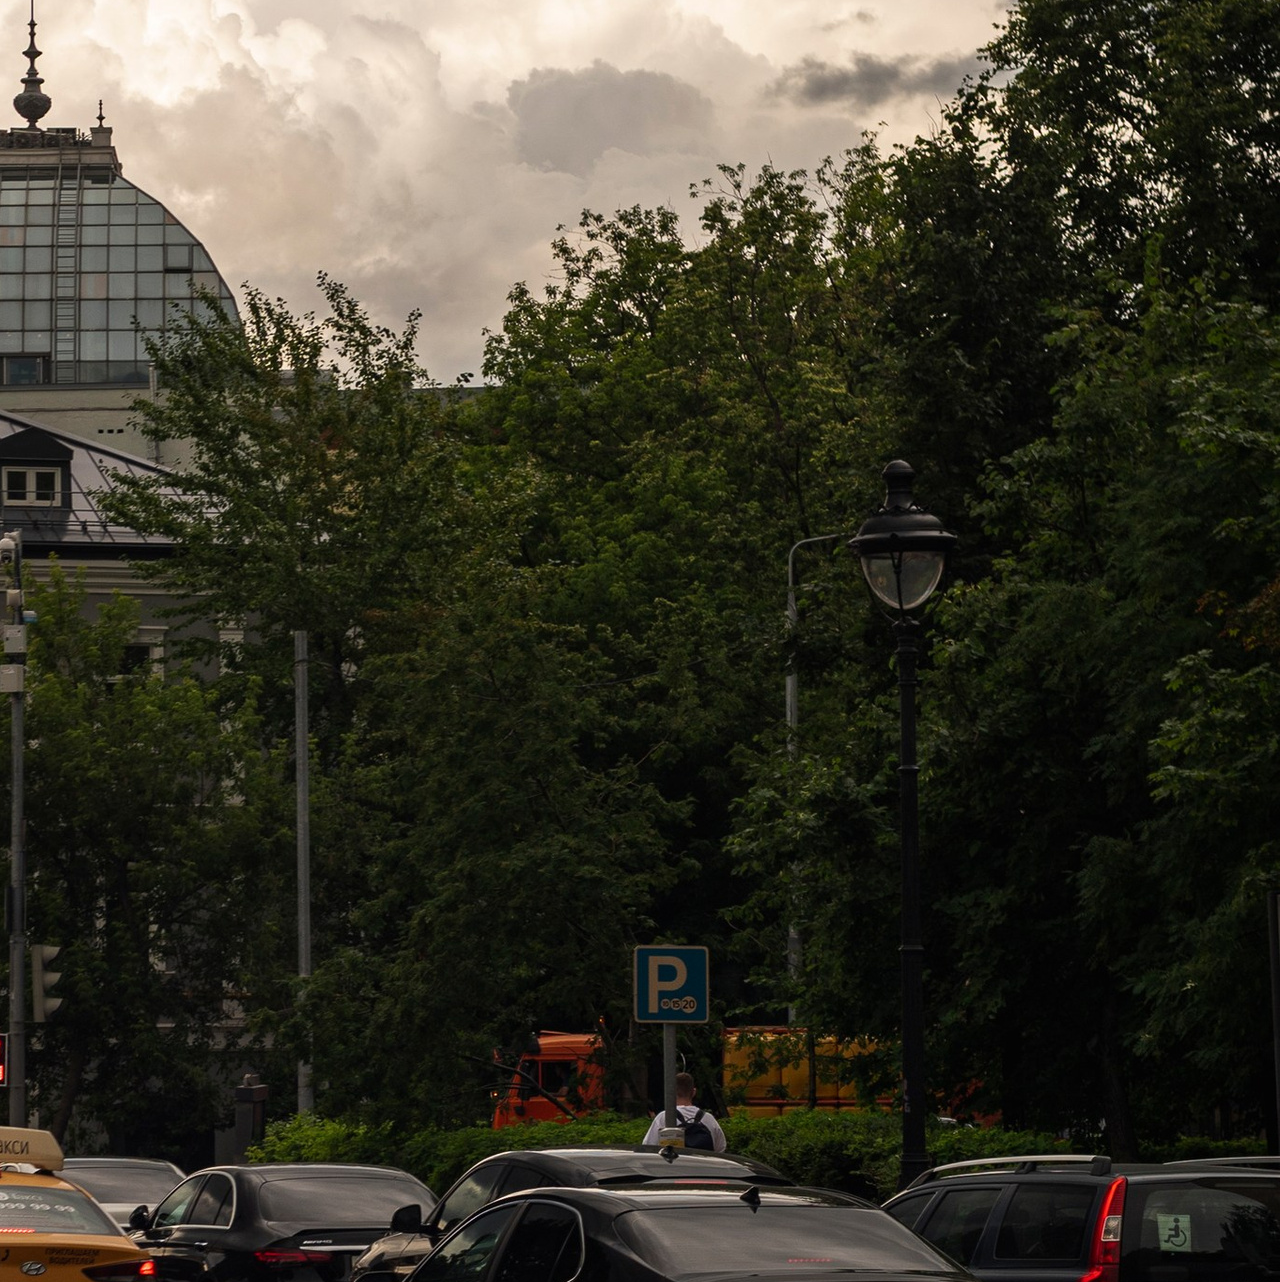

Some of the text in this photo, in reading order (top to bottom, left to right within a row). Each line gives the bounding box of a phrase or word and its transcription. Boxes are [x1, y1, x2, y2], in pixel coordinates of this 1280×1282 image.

[648, 955, 688, 1014] P
[672, 1000, 680, 1009] 15
[682, 999, 696, 1009] 20
